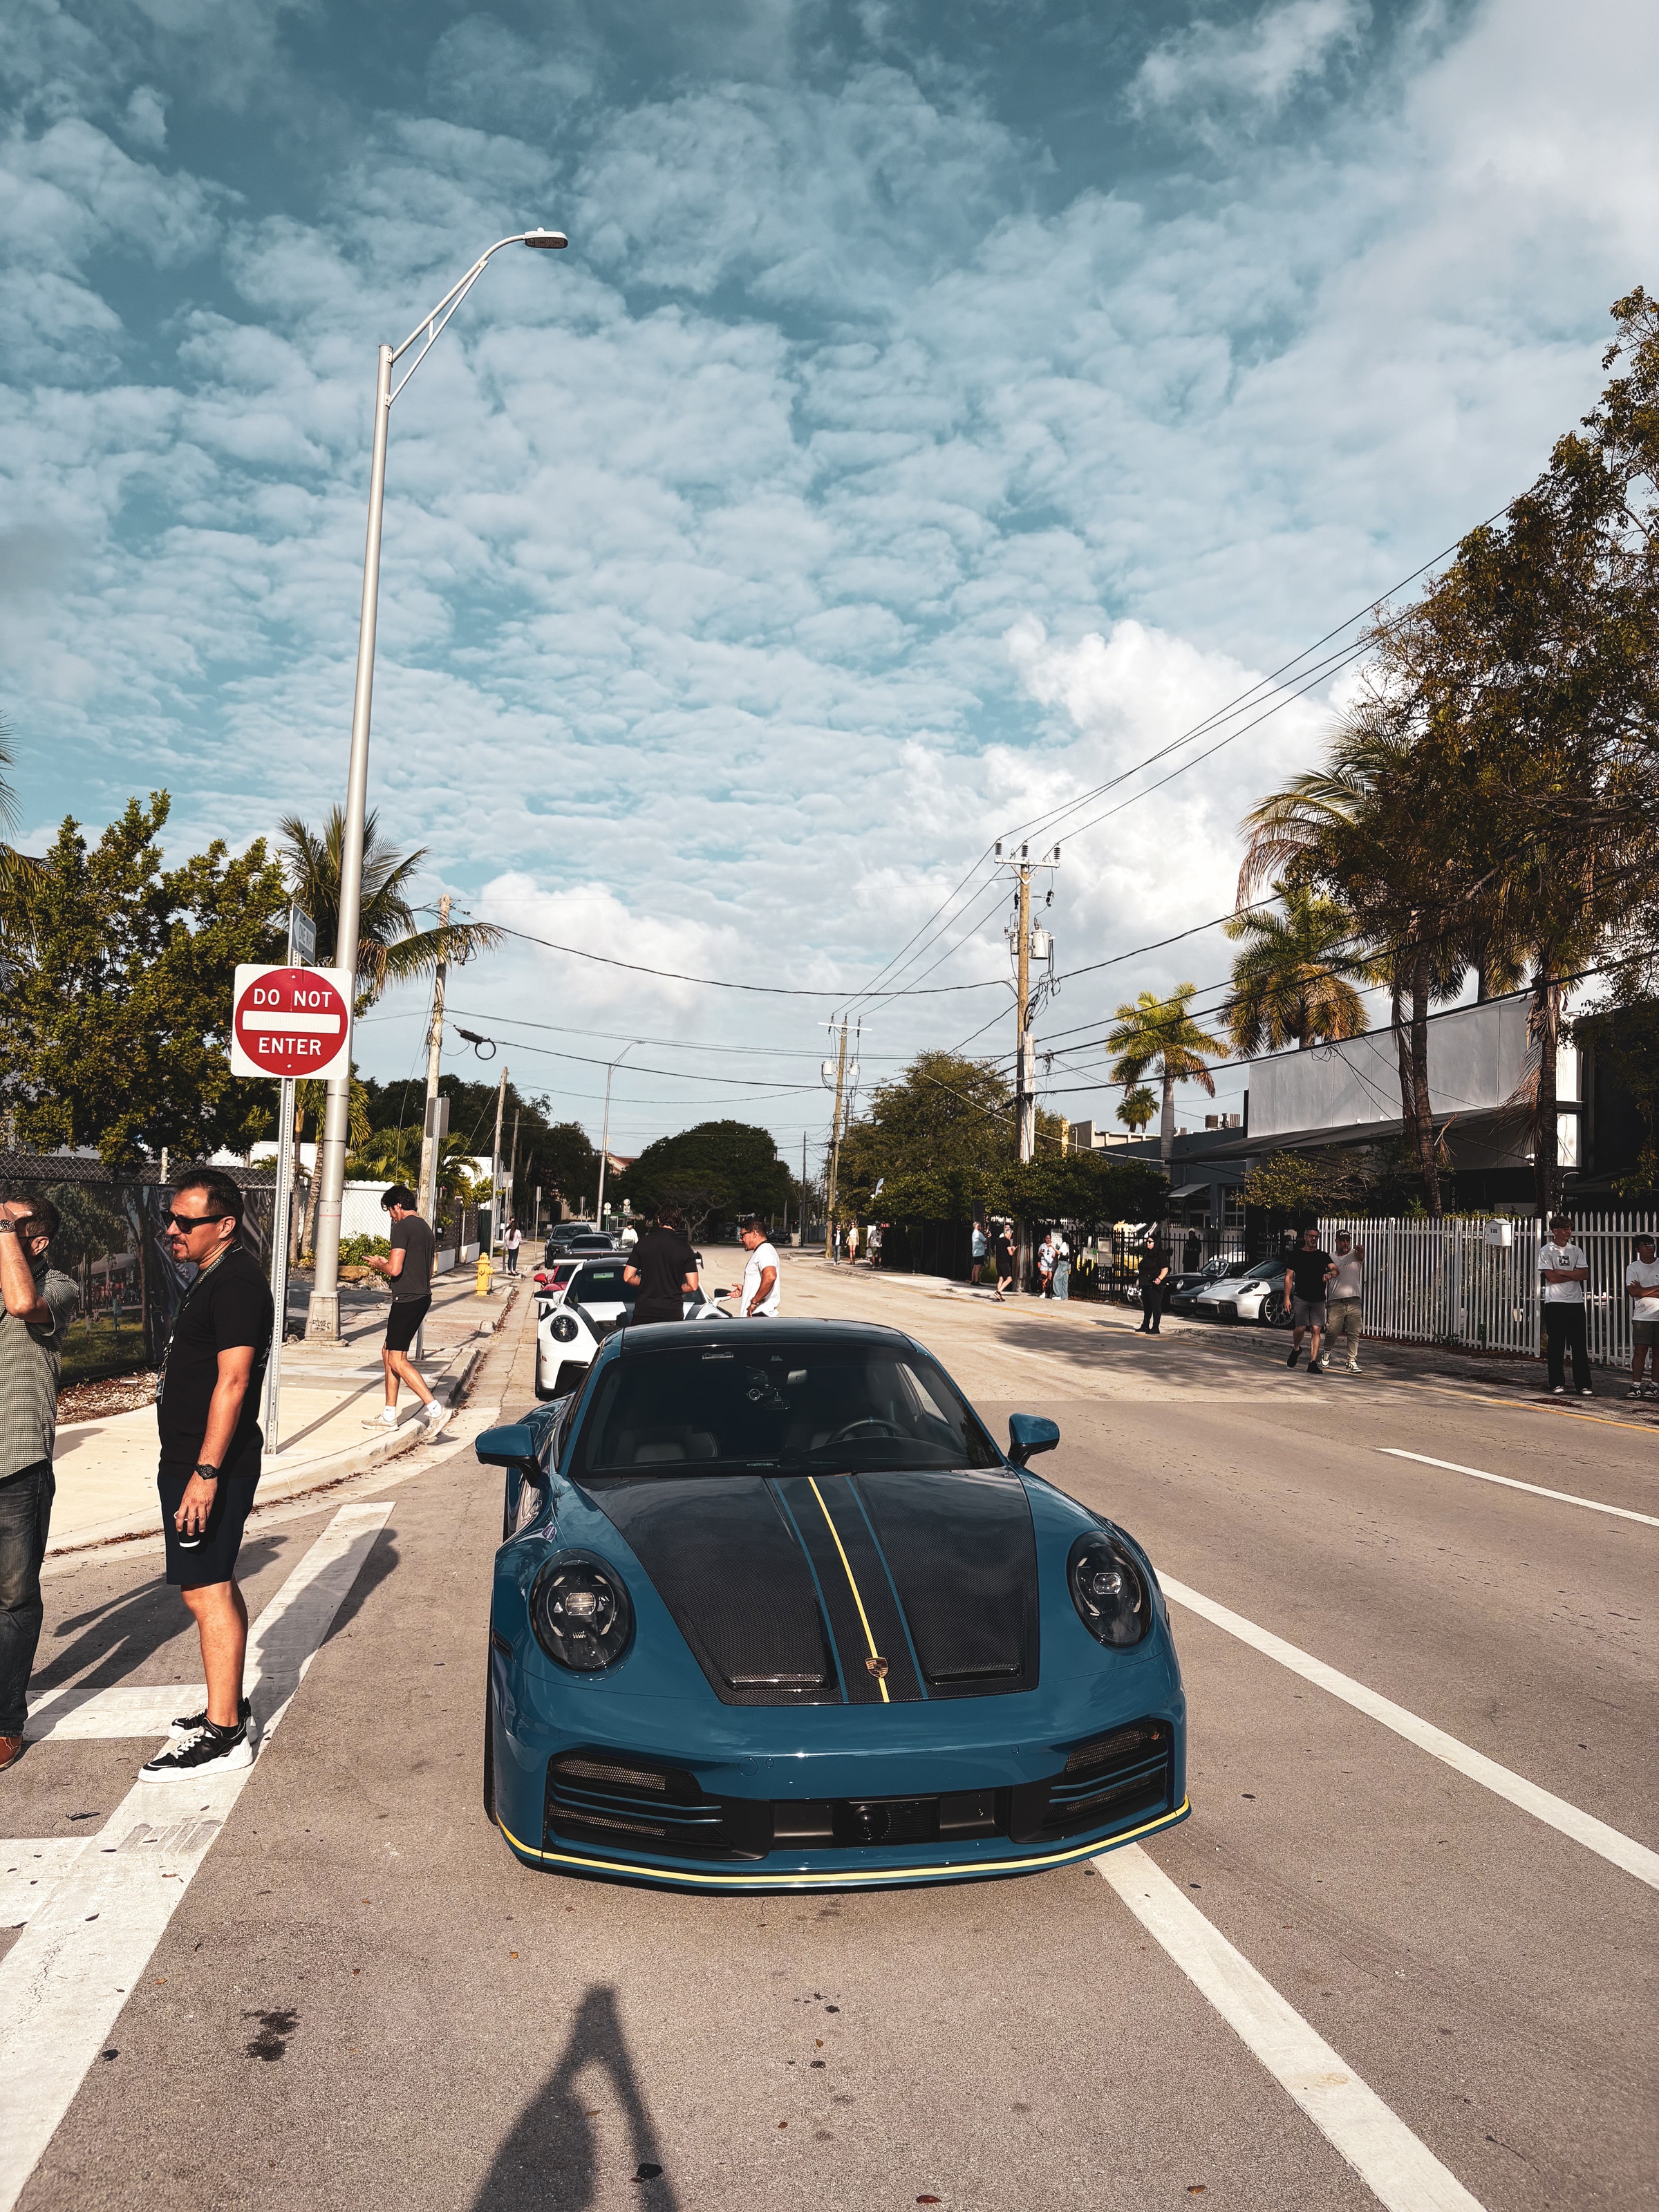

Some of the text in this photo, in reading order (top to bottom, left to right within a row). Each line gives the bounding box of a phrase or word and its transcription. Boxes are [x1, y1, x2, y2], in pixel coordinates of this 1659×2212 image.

[254, 988, 332, 1008] DO NOT
[259, 1037, 321, 1056] ENTER
